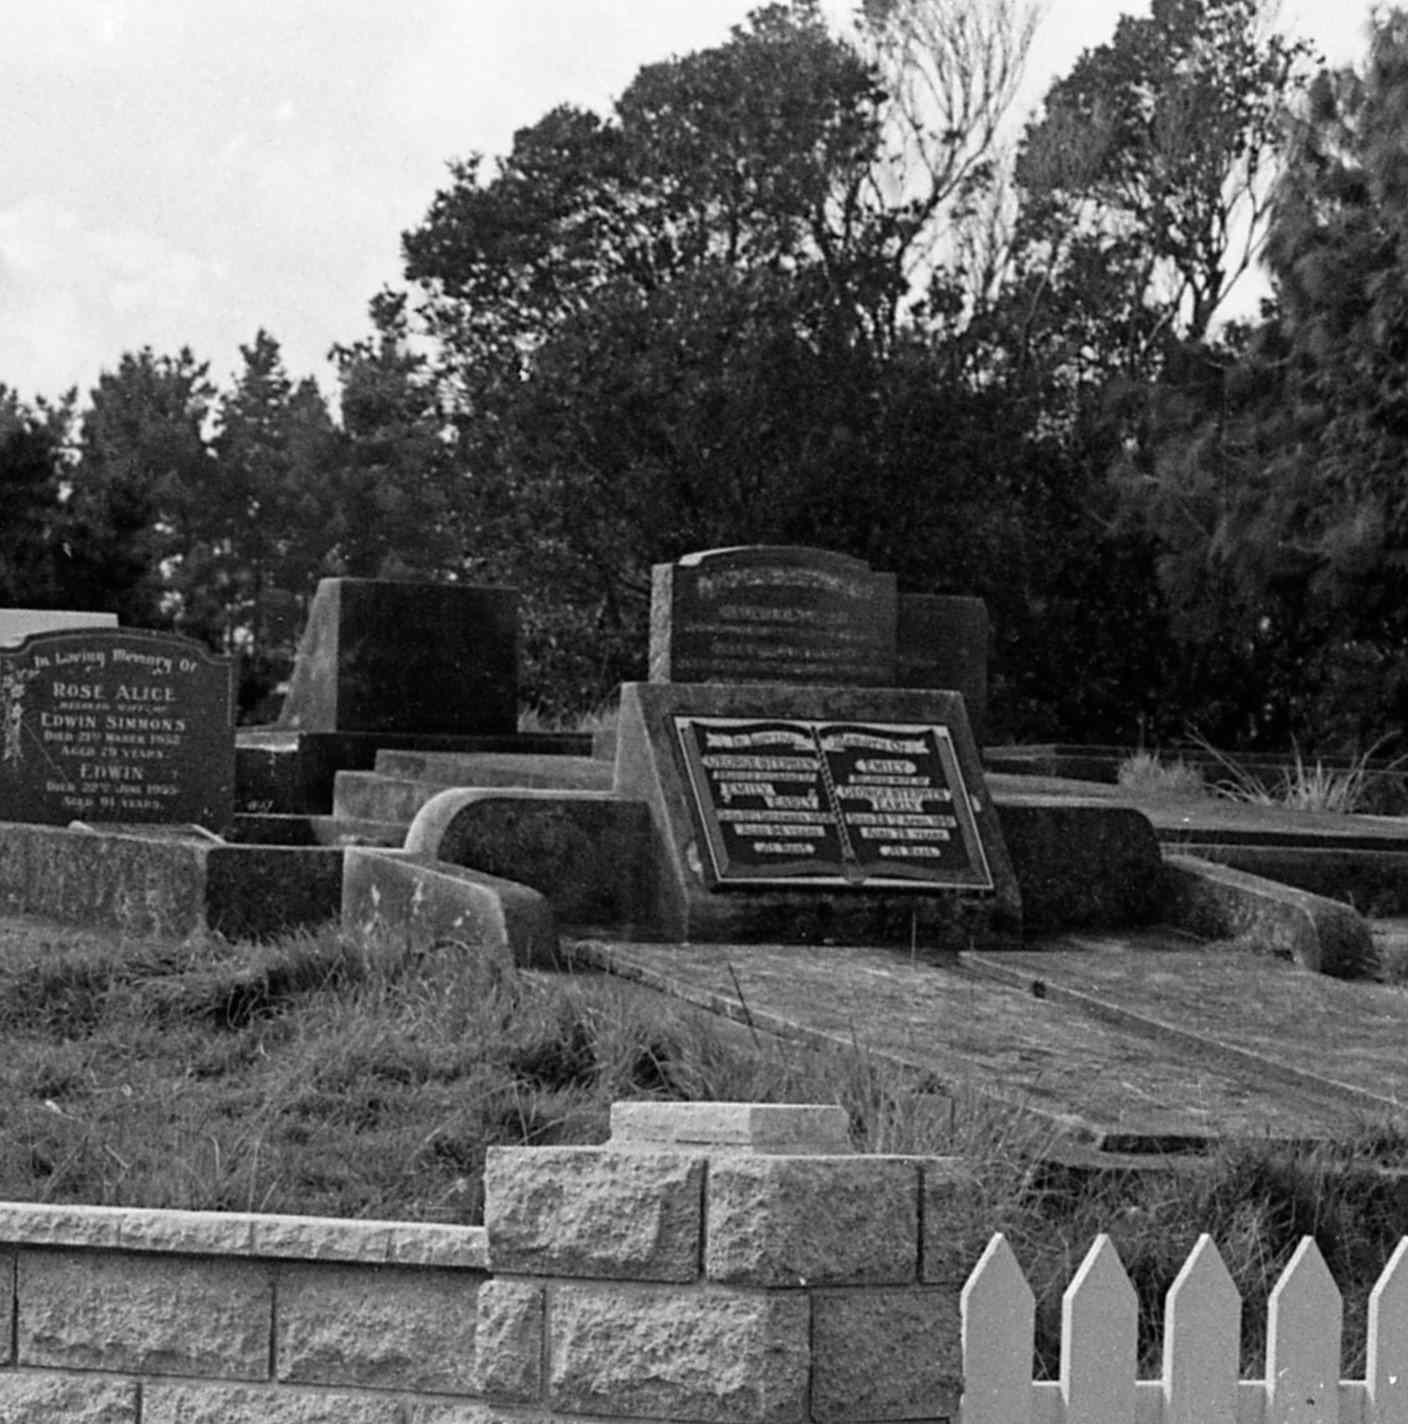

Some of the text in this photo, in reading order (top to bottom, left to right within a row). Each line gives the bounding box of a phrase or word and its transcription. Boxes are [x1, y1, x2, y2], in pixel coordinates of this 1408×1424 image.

[35, 655, 50, 667] In
[55, 651, 105, 671] Loving
[113, 649, 172, 674] Memory
[53, 682, 176, 702] ROSE ALICE
[41, 712, 186, 731] EDWIN SIMMONS
